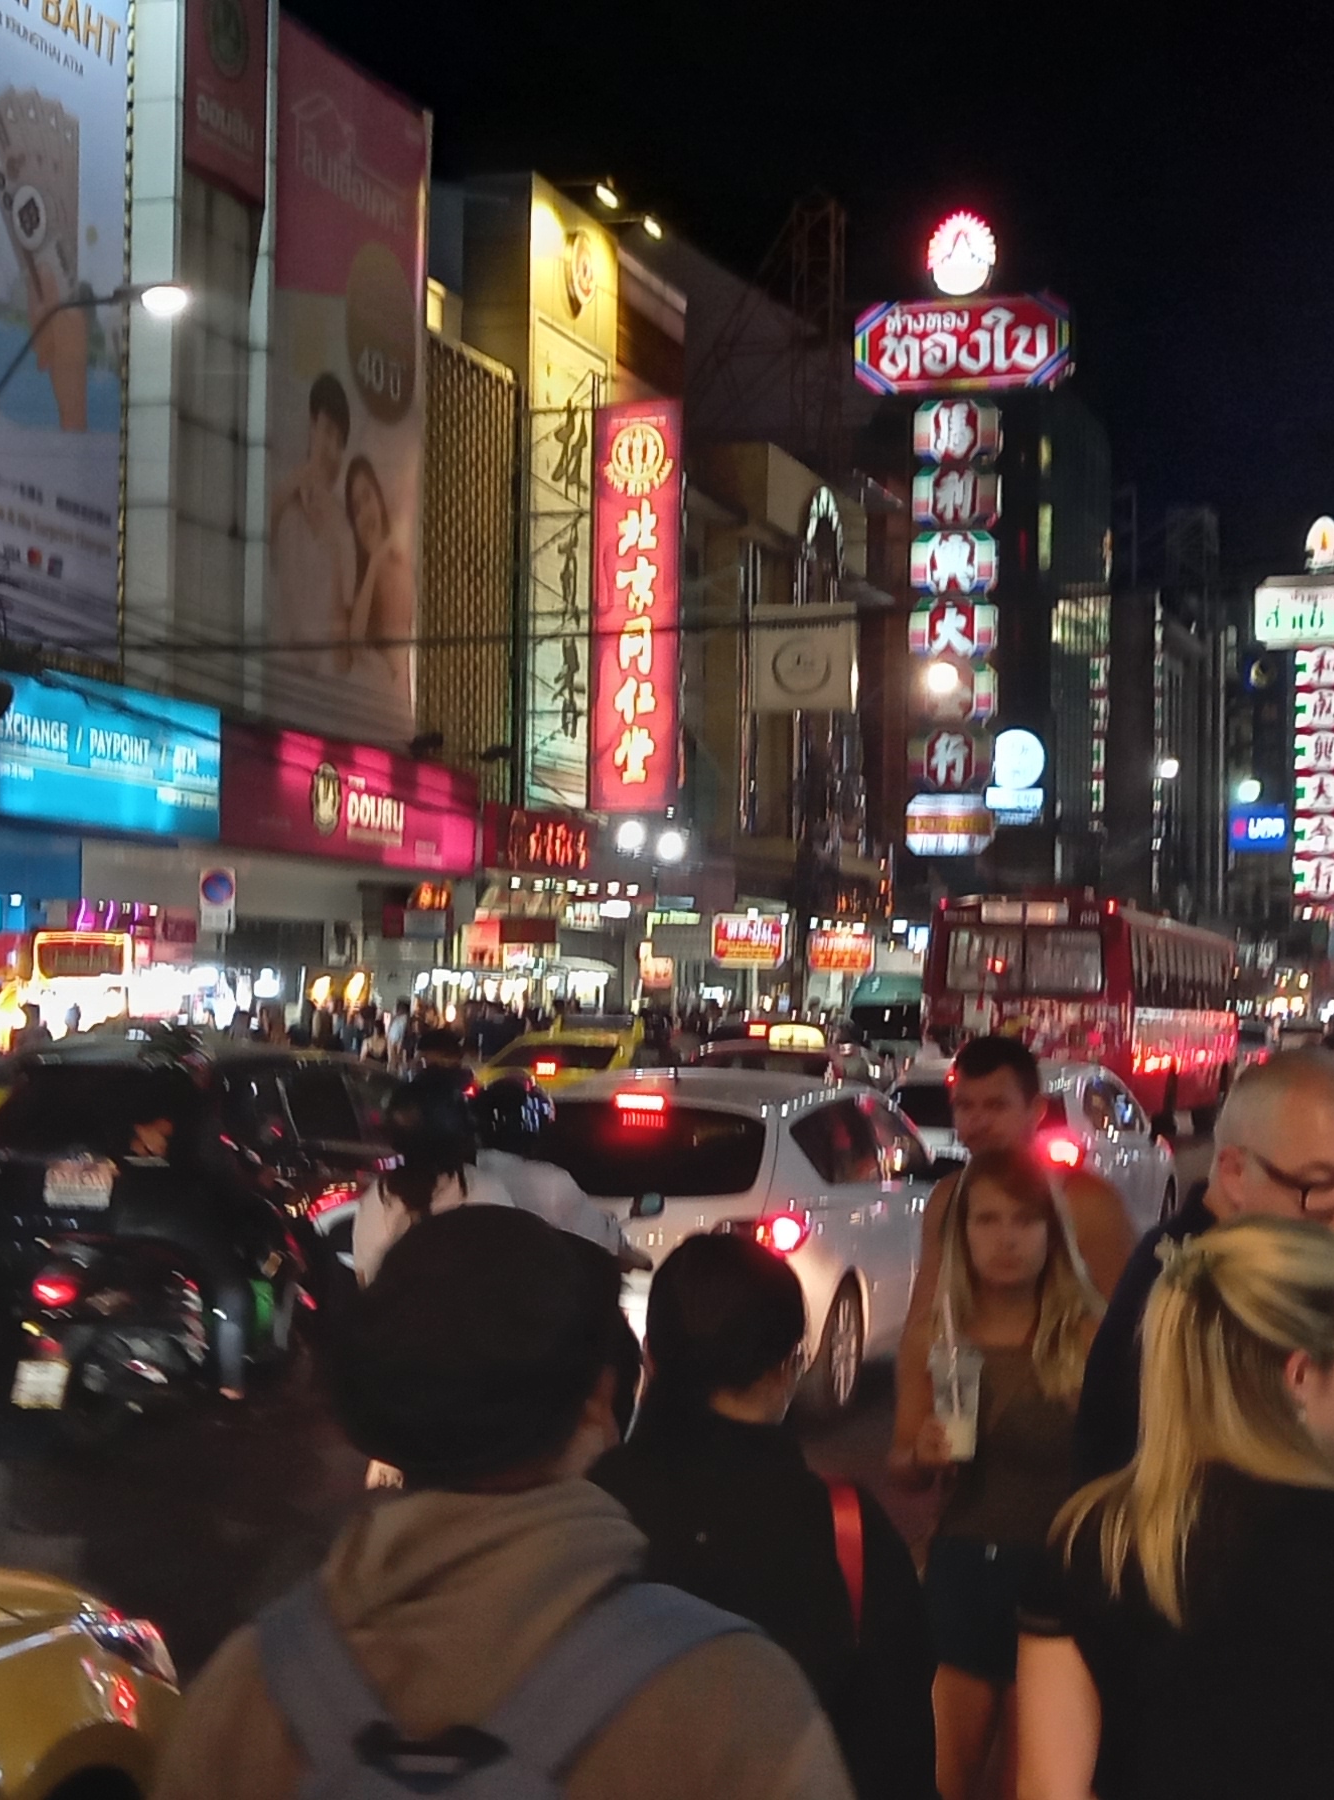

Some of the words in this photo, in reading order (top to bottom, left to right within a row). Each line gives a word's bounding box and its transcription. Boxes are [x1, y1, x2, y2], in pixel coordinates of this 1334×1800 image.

[5, 13, 61, 65] KRUNGTHAI
[62, 54, 85, 77] ATM
[41, 0, 121, 67] BAHT
[879, 306, 1048, 379] ทองใบ
[886, 308, 970, 335] ห้างทอง
[613, 499, 660, 785] 北京同仁堂
[88, 727, 151, 762] PAYPOINT
